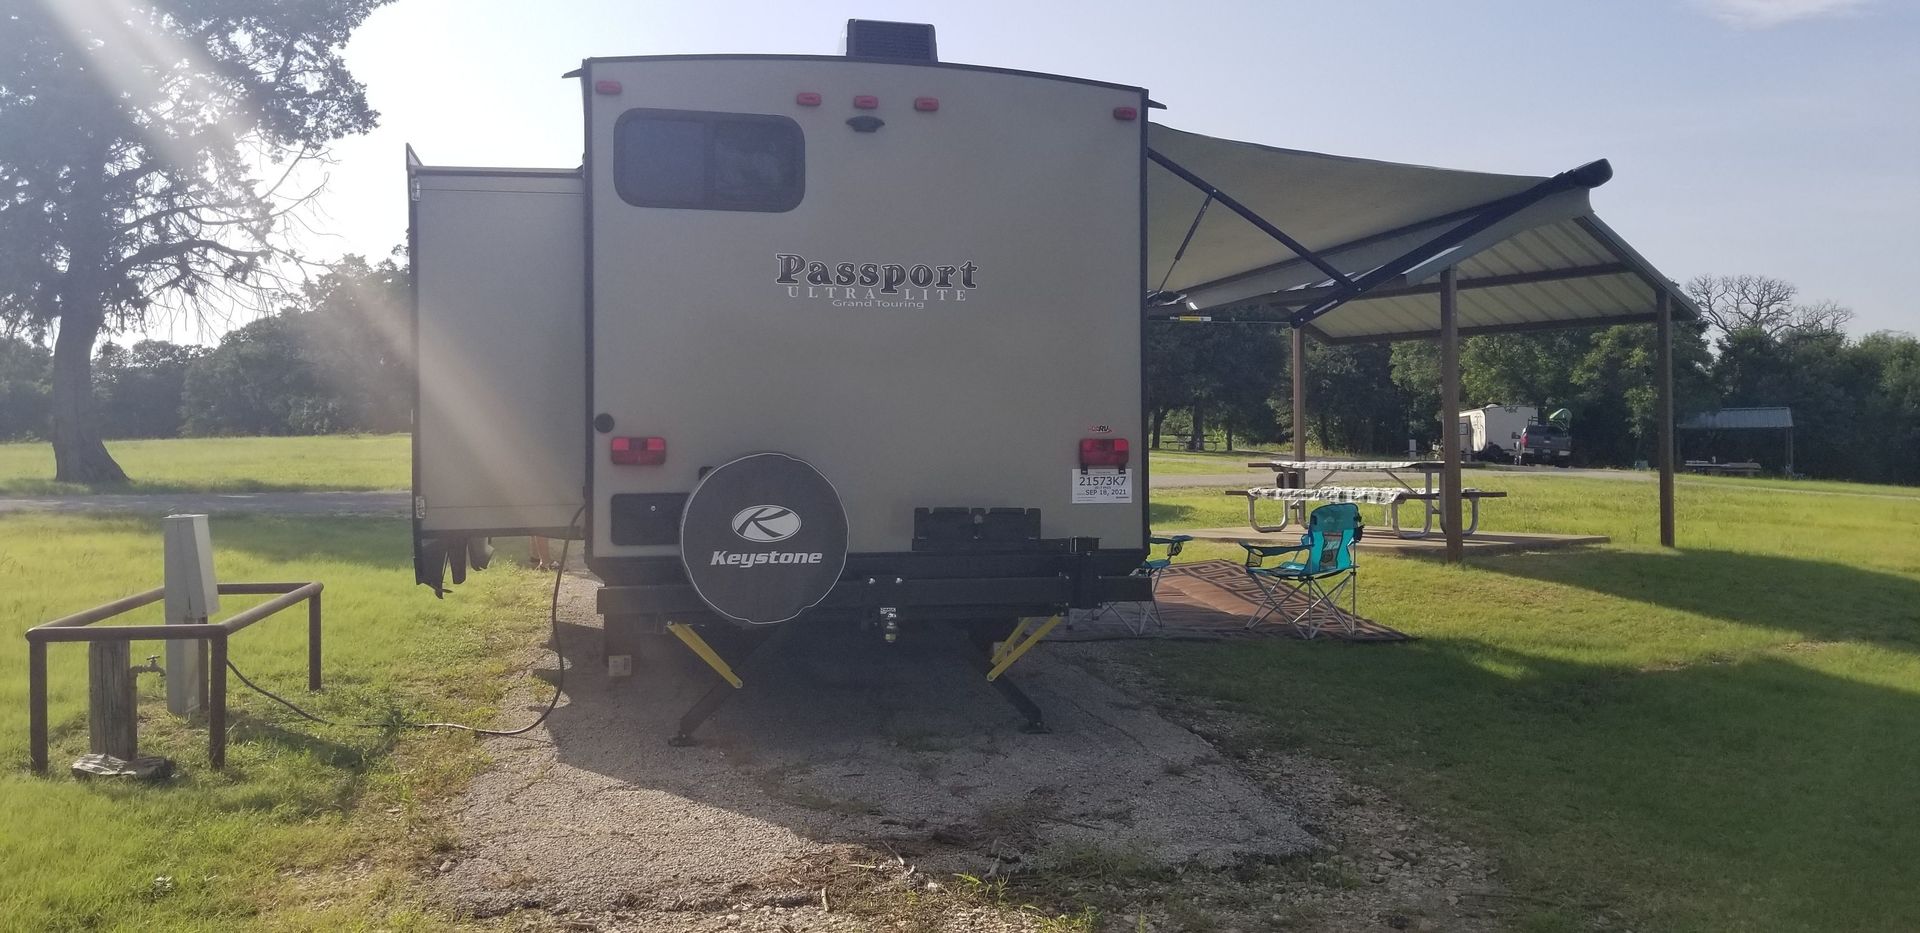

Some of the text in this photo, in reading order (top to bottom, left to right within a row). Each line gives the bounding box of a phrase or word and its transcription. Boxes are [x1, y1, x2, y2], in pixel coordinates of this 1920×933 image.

[775, 253, 978, 295] Passport
[787, 286, 967, 301] ULTRA LITE
[832, 299, 925, 310] Grand Touring
[1079, 476, 1127, 486] 21573K7
[710, 550, 823, 569] Keystone
